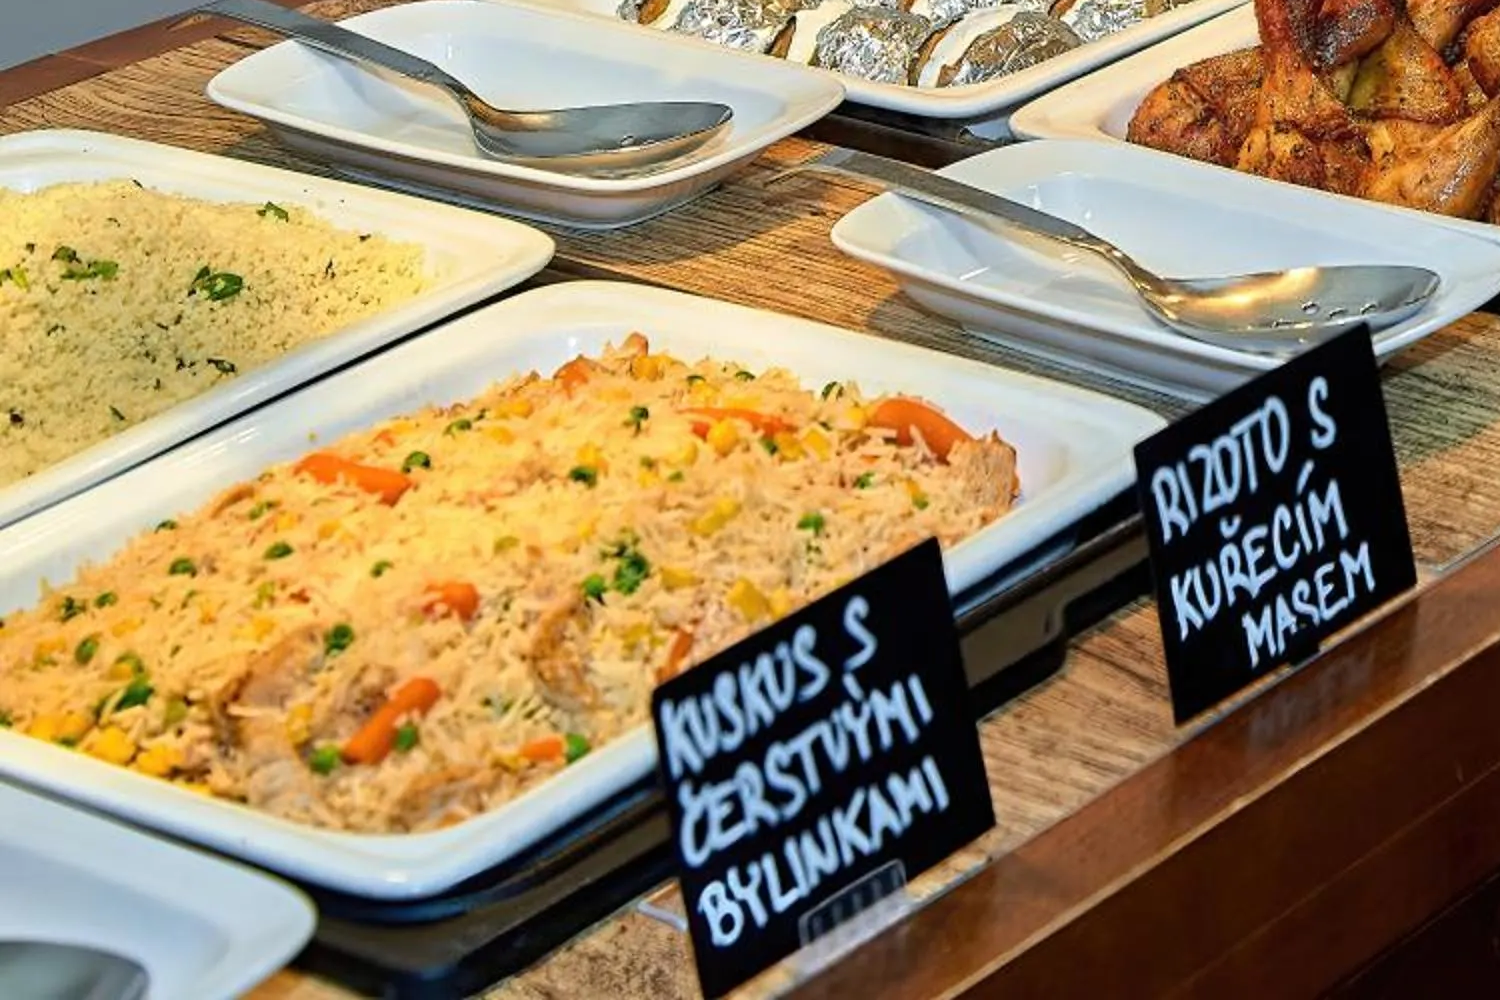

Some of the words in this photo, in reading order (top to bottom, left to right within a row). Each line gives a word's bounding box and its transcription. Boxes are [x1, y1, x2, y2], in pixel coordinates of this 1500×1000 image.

[1151, 396, 1290, 545] RIZOTO
[1308, 376, 1336, 450] S
[1170, 459, 1350, 642] KUŘECÍM
[660, 624, 830, 780] KUSKUS
[842, 596, 878, 672] S
[1241, 541, 1376, 669] MASEM
[697, 756, 949, 946] BYLINKAMI
